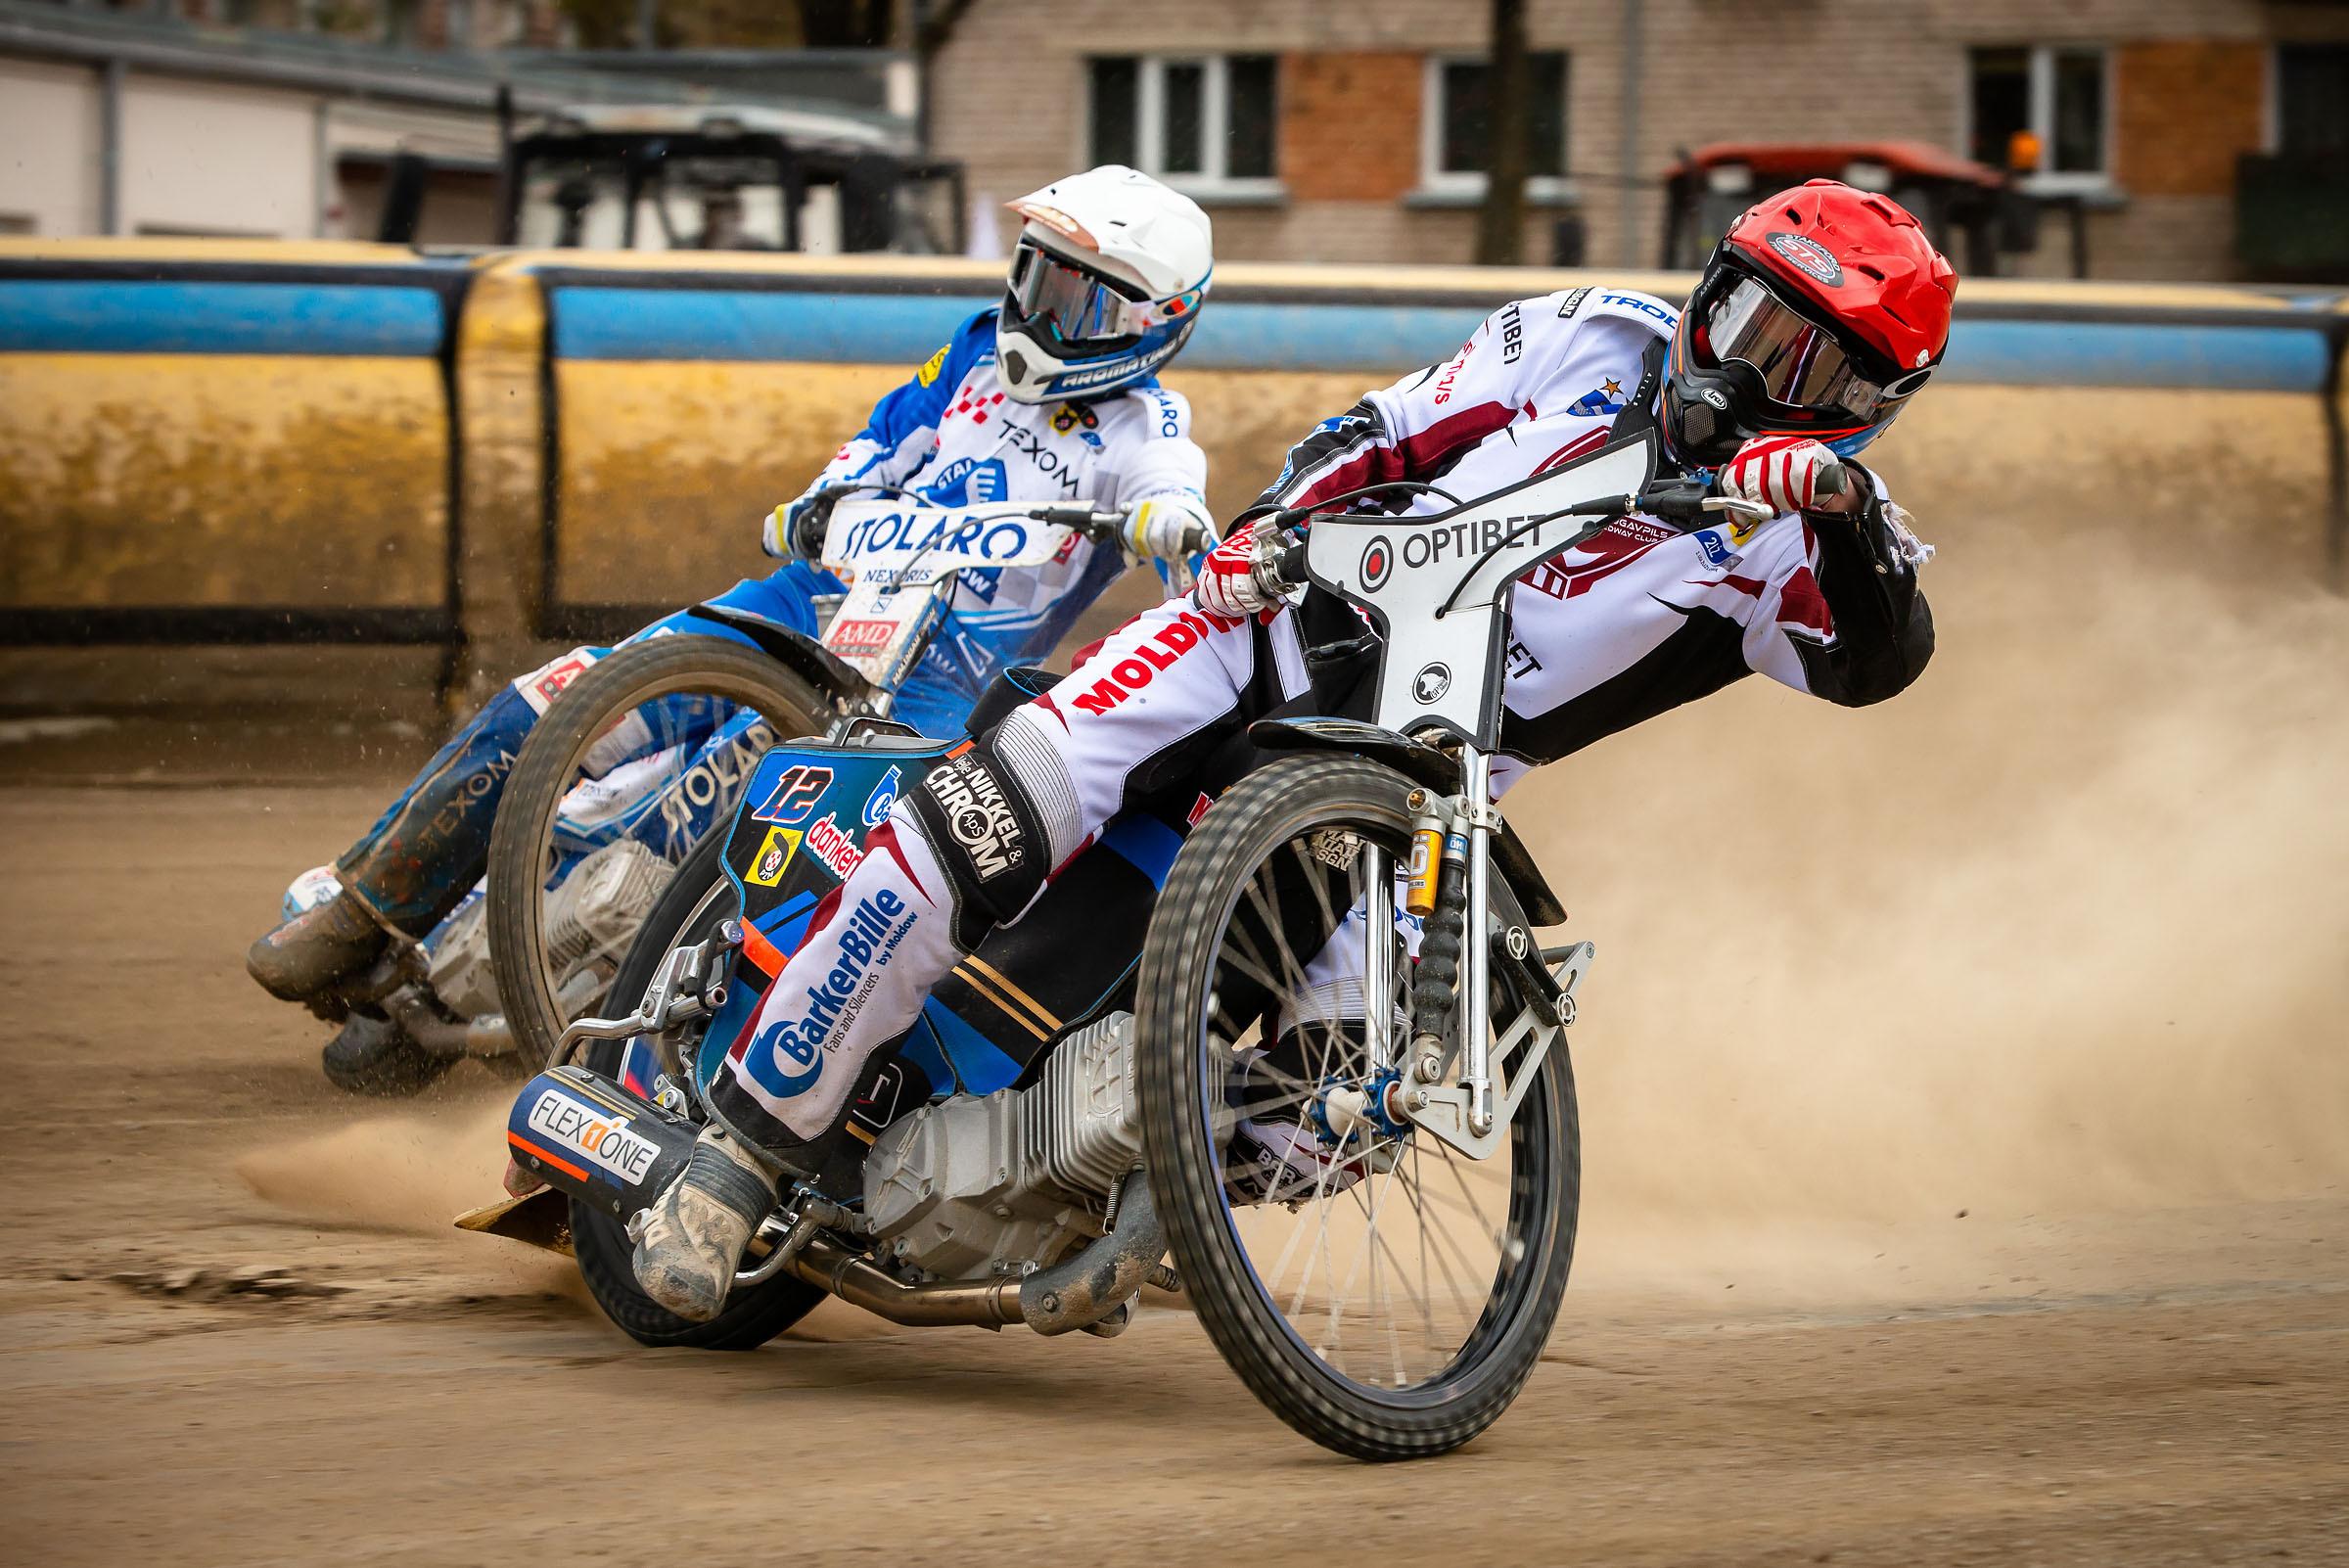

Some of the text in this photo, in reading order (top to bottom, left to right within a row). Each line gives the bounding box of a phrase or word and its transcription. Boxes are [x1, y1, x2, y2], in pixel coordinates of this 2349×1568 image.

[1780, 239, 1828, 273] STS
[1785, 234, 1841, 272] STAKEFORD
[1633, 372, 1653, 406] ATLAS
[998, 419, 1080, 497] TEXOM
[840, 514, 1027, 560] STOLARO
[1403, 514, 1546, 569] OPTIBET
[834, 623, 893, 643] AMD
[953, 756, 972, 774] Vejle
[417, 750, 519, 850] TEXOM
[752, 765, 834, 824] 12
[926, 765, 1008, 878] CHROM
[965, 767, 1022, 863] NIKKEL &
[962, 812, 985, 837] ApS
[759, 865, 776, 881] PZM
[875, 911, 919, 966] by Moldow
[778, 889, 906, 1067] BarkerBille
[823, 971, 880, 1054] Fans and Silencers
